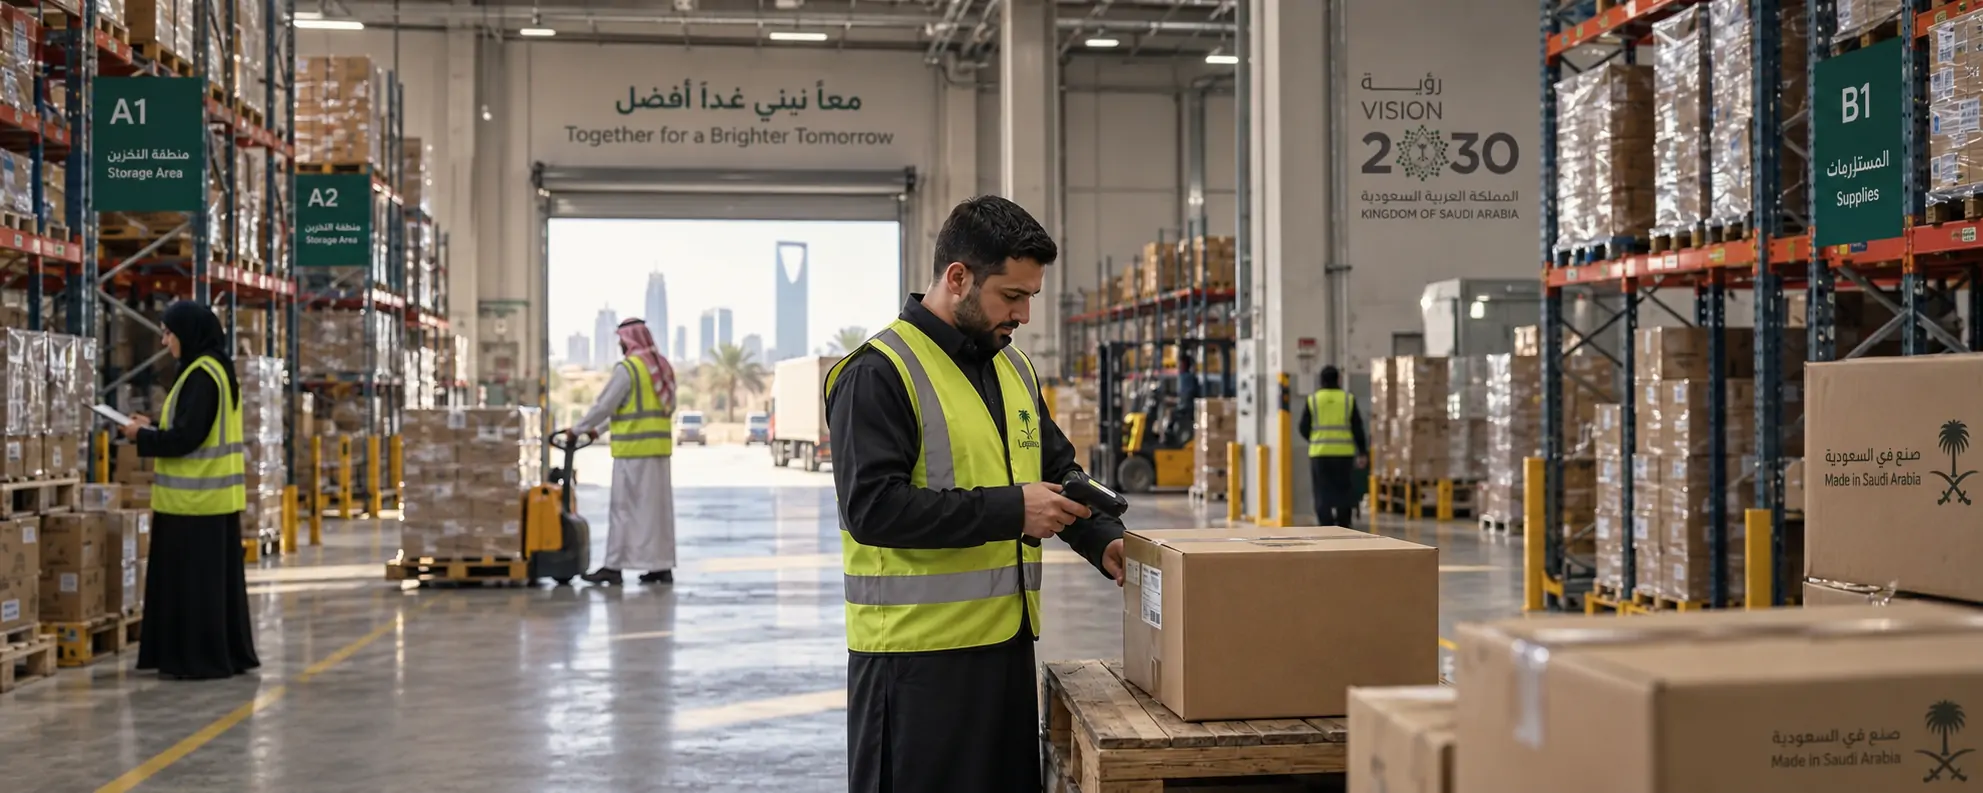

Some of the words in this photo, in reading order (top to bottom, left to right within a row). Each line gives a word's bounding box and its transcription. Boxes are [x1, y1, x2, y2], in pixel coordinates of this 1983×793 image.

[616, 78, 691, 115] أفضل
[754, 89, 807, 122] نيني
[1842, 82, 1869, 123] B1
[110, 98, 145, 124] A1
[1361, 101, 1442, 120] VISION
[565, 126, 654, 147] Together
[660, 126, 688, 143] for
[693, 131, 704, 143] a
[711, 126, 789, 148] Brighter
[795, 127, 894, 145] Tomorrow
[108, 167, 153, 180] Storage
[156, 167, 183, 178] Area
[308, 188, 338, 207] A2
[1361, 190, 1421, 204] السعودية
[1425, 191, 1465, 205] العربية
[1469, 190, 1518, 202] المملكة
[1837, 187, 1879, 208] Supplies
[1362, 209, 1417, 219] KINGDOM
[1420, 209, 1436, 219] OF
[1440, 209, 1473, 219] SAUDI
[1477, 209, 1519, 219] ARABIA
[306, 236, 337, 245] Storage
[339, 236, 358, 244] Area
[1826, 448, 1873, 466] السعودية
[1876, 448, 1893, 468] في
[1896, 448, 1920, 466] صنع
[1825, 473, 1850, 486] Made
[1853, 473, 1860, 486] in
[1863, 472, 1888, 486] Saudi
[1891, 472, 1921, 485] Arabia
[1772, 728, 1839, 748] السعودية
[1842, 728, 1865, 749] في
[1869, 728, 1900, 746] صنع
[1772, 754, 1806, 768] Made
[1809, 753, 1820, 767] in
[1823, 752, 1857, 766] Saudi
[1861, 750, 1901, 764] Arabia
